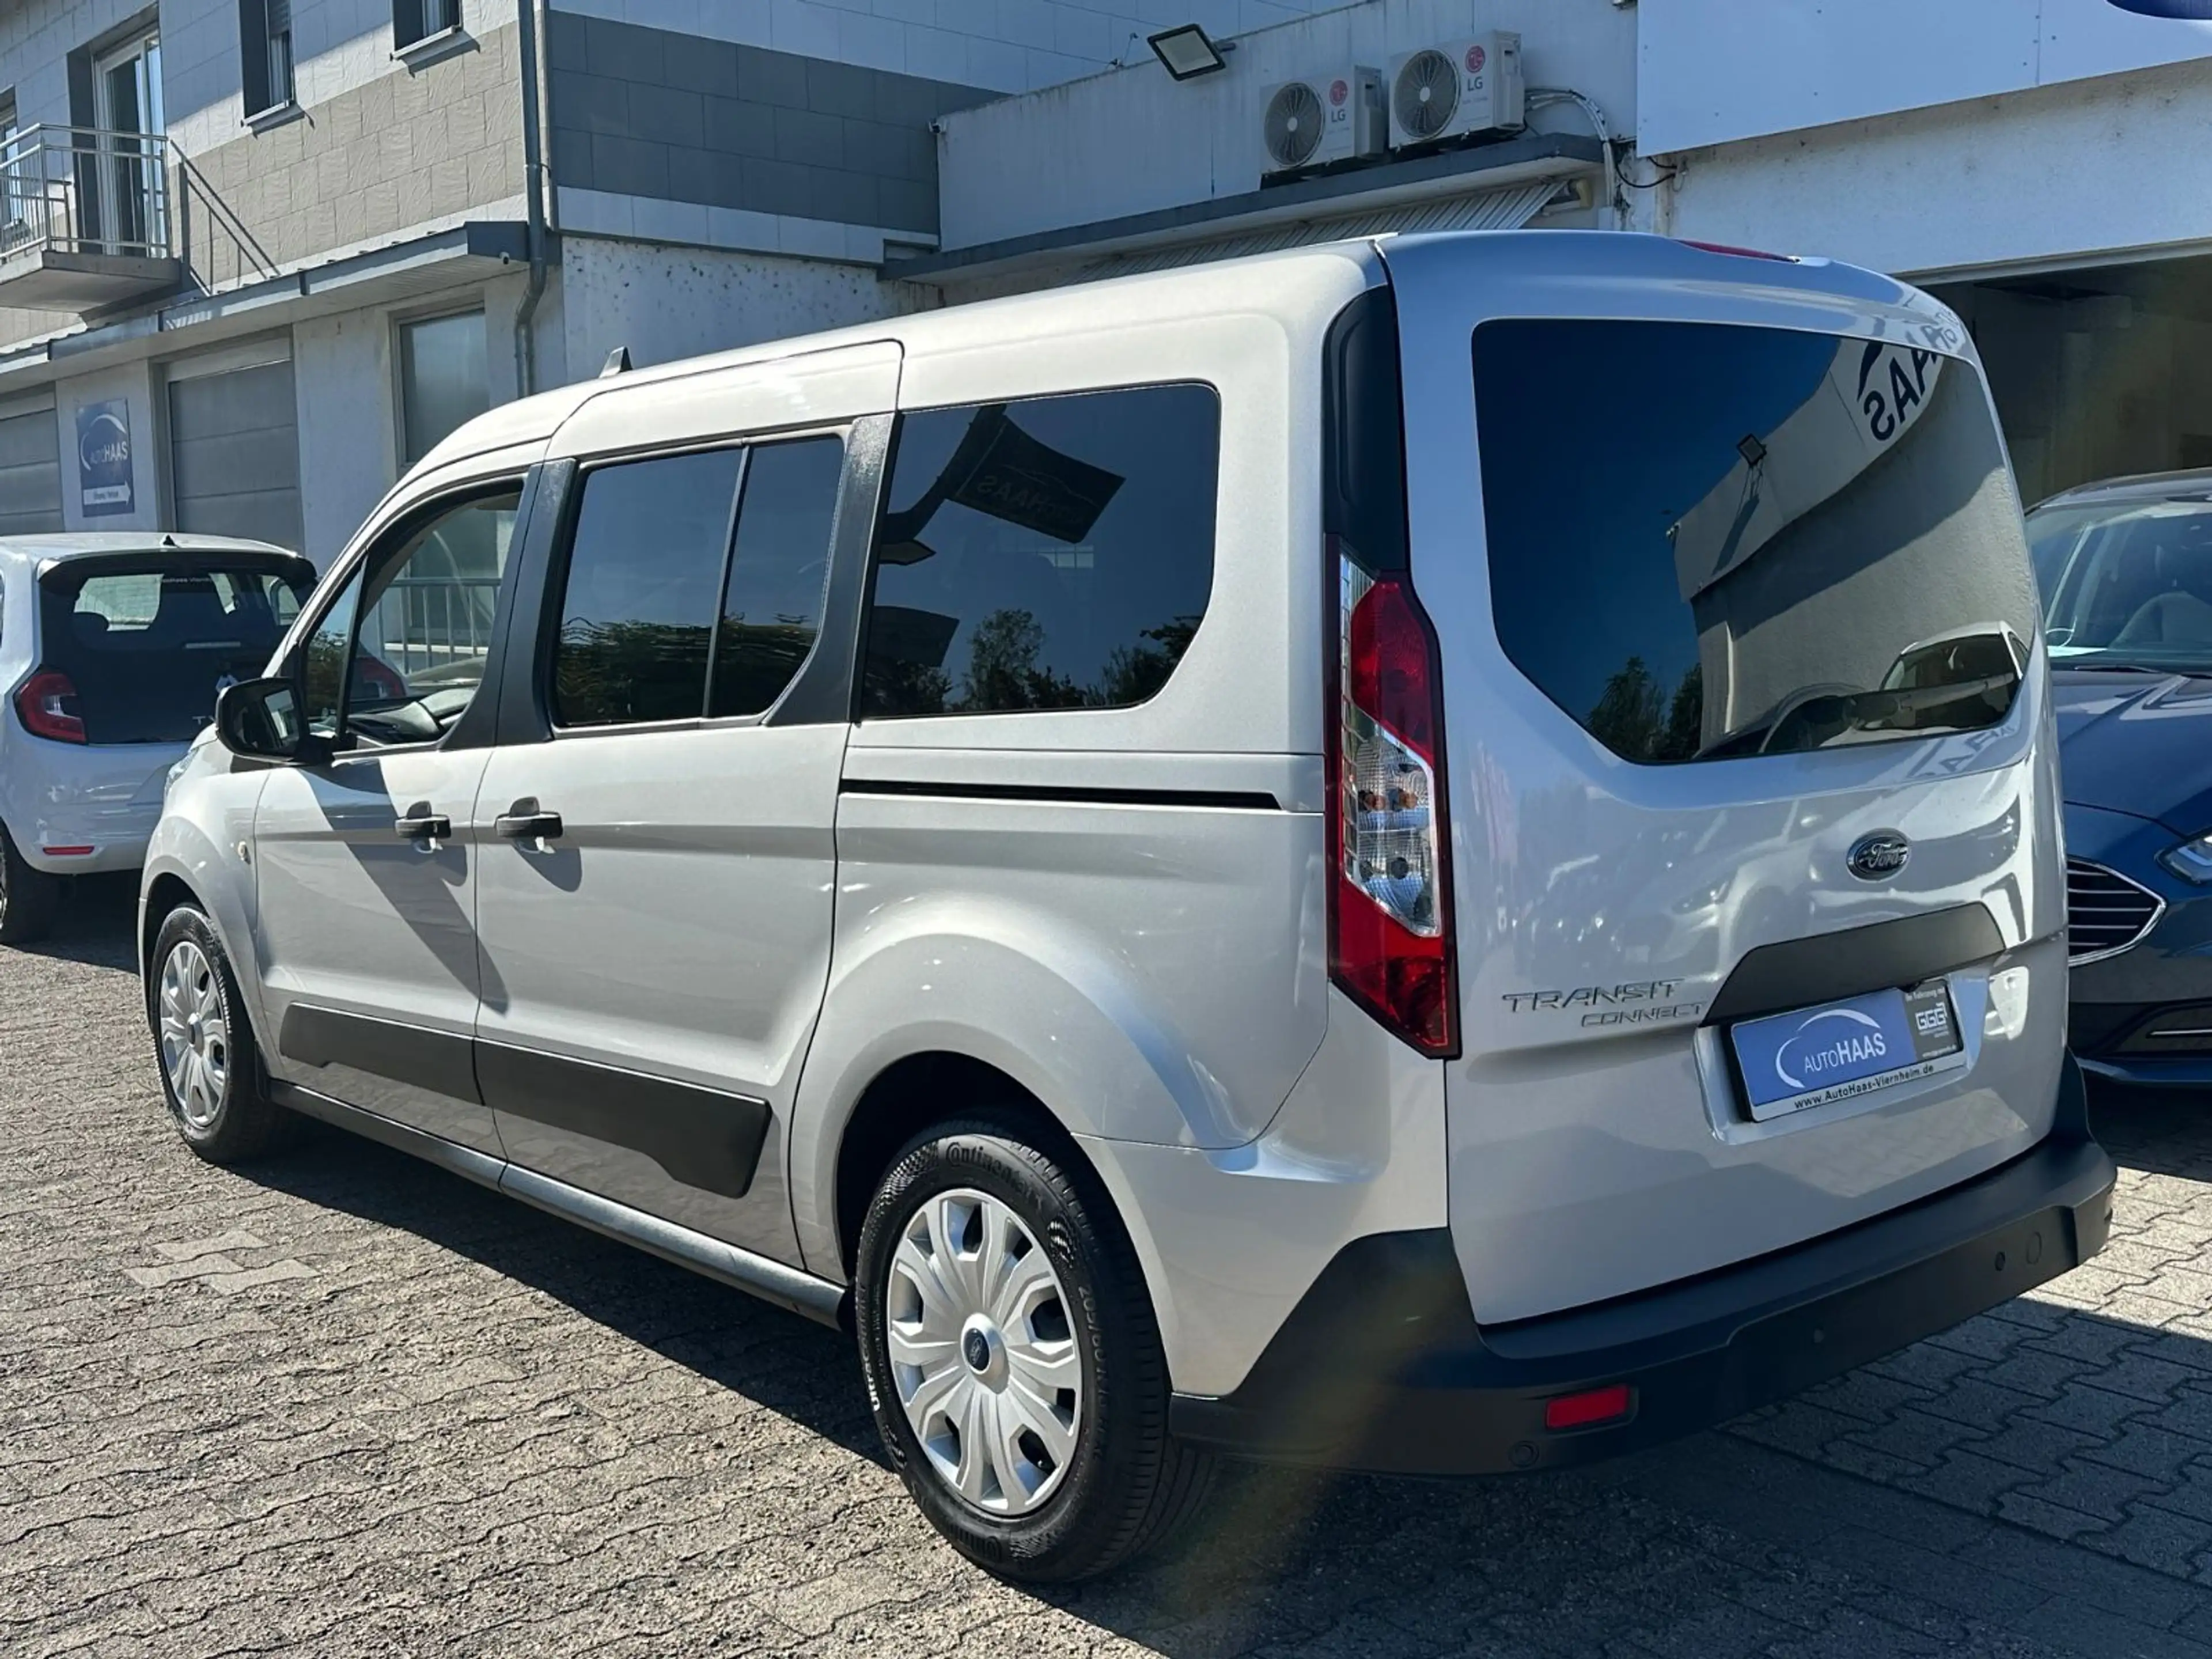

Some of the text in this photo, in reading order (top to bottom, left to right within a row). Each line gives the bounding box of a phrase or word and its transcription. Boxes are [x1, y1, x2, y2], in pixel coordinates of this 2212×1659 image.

[1467, 76, 1483, 91] LG
[1331, 109, 1346, 123] LG
[1502, 978, 1685, 1013] TRANSIT
[1581, 1000, 1707, 1028] CONNECT
[1804, 1032, 1887, 1074] AUTOHAAS
[1794, 1063, 1934, 1109] www.AutoHaas-Viernheim.de
